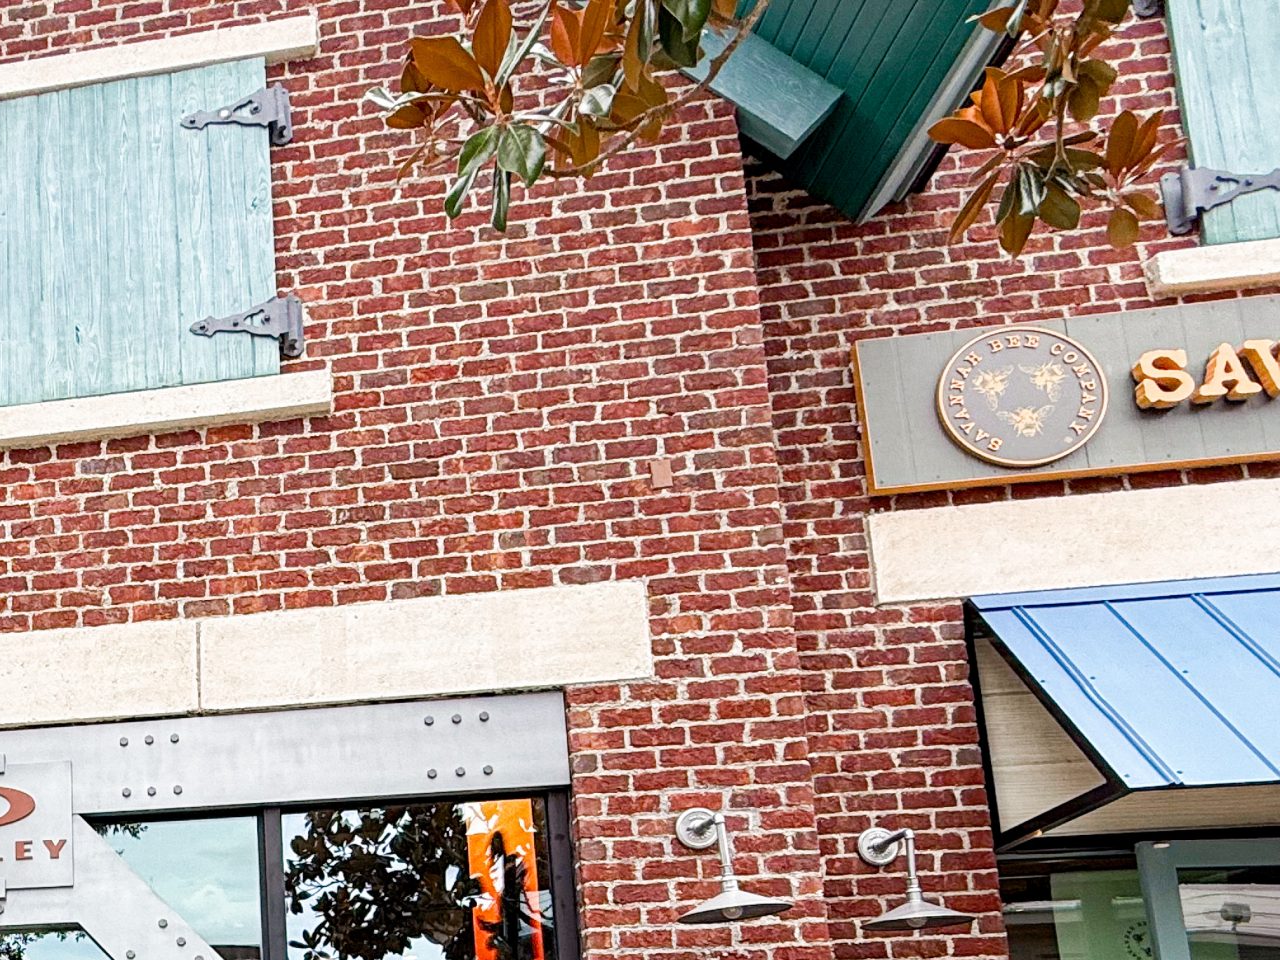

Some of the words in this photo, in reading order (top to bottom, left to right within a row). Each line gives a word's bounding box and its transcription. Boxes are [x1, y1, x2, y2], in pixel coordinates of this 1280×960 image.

[949, 350, 1003, 451] SAVANNAH
[988, 333, 1041, 354] BEE
[1050, 341, 1098, 436] COMPANY
